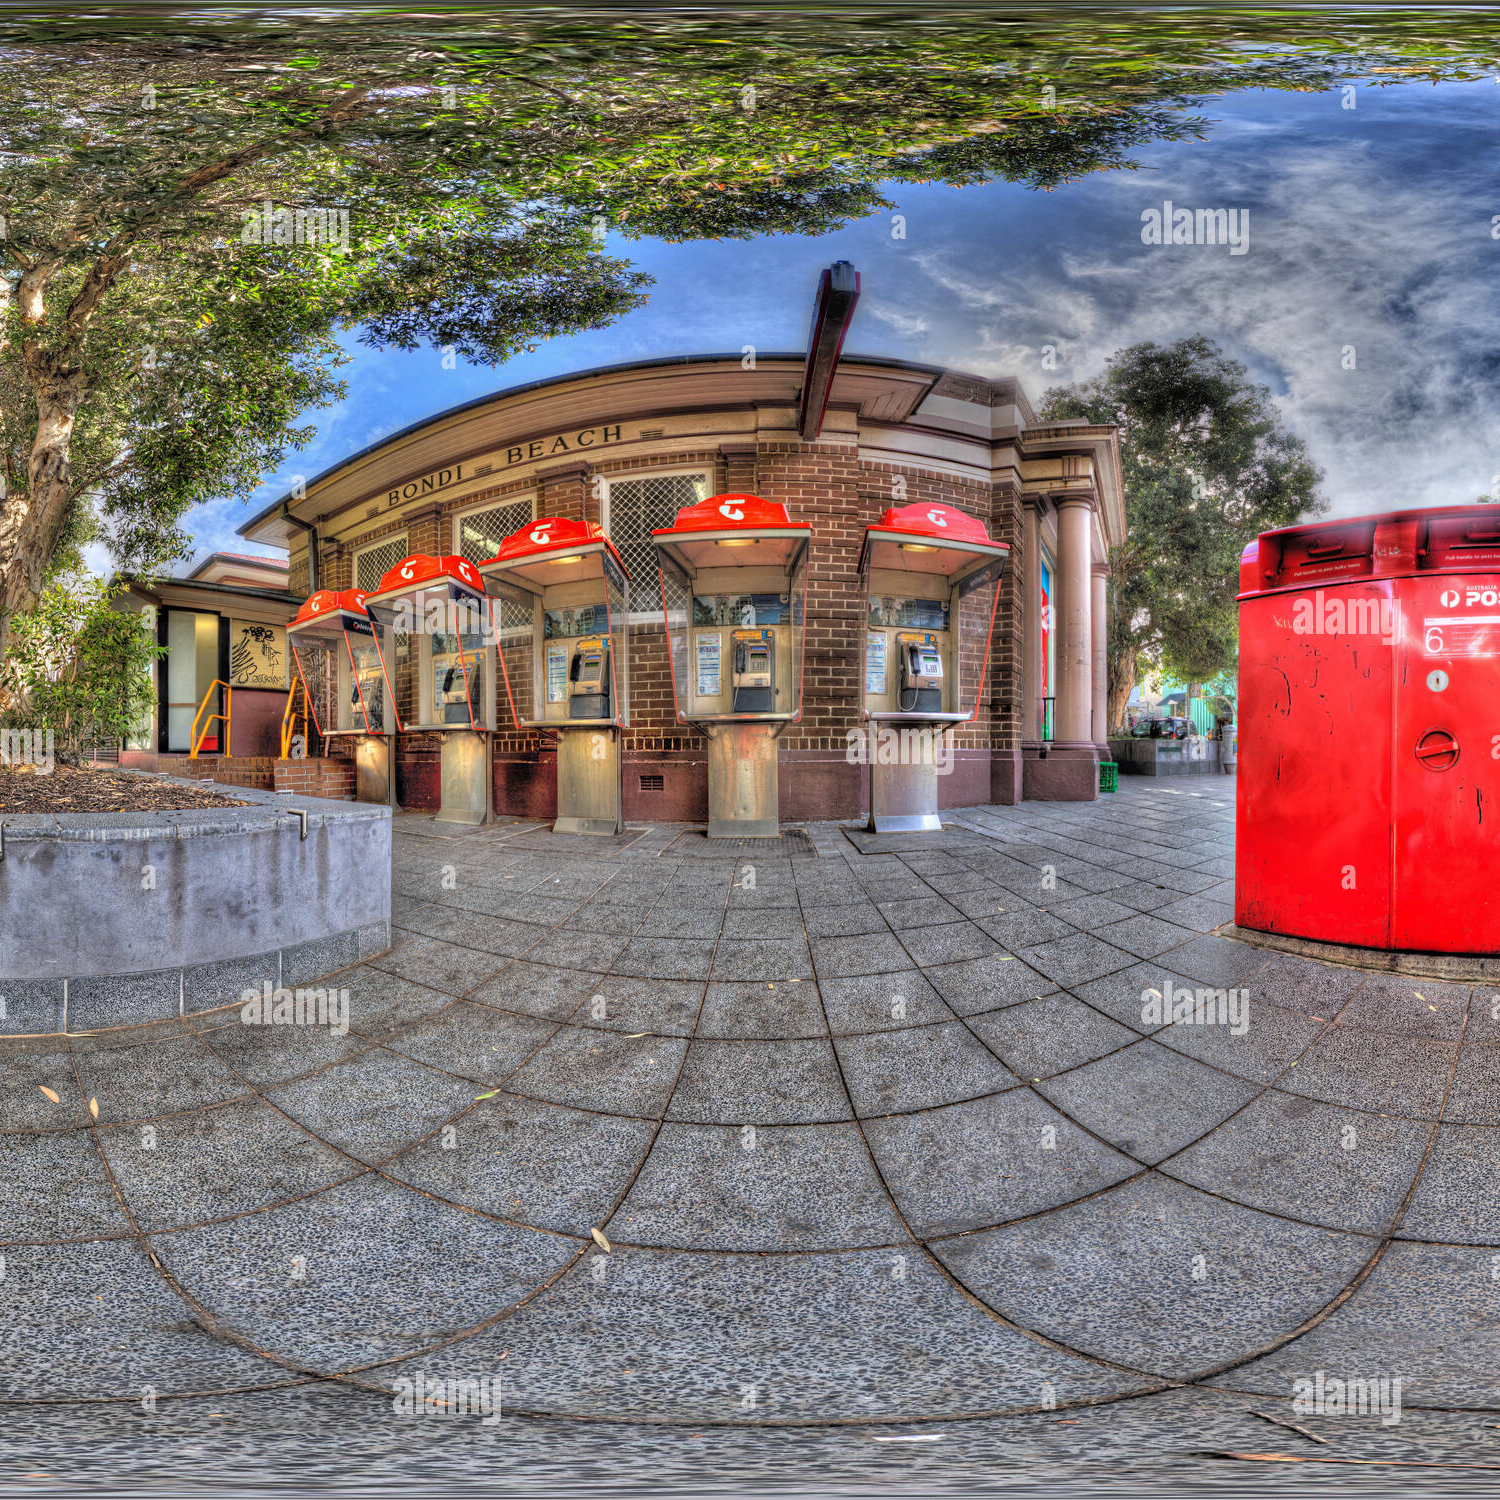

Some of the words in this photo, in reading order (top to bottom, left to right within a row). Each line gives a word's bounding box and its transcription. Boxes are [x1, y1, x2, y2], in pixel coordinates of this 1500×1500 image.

[388, 466, 464, 507] BONDI
[507, 425, 624, 465] BEACH
[1466, 591, 1500, 607] PO
[1425, 627, 1443, 653] 6
